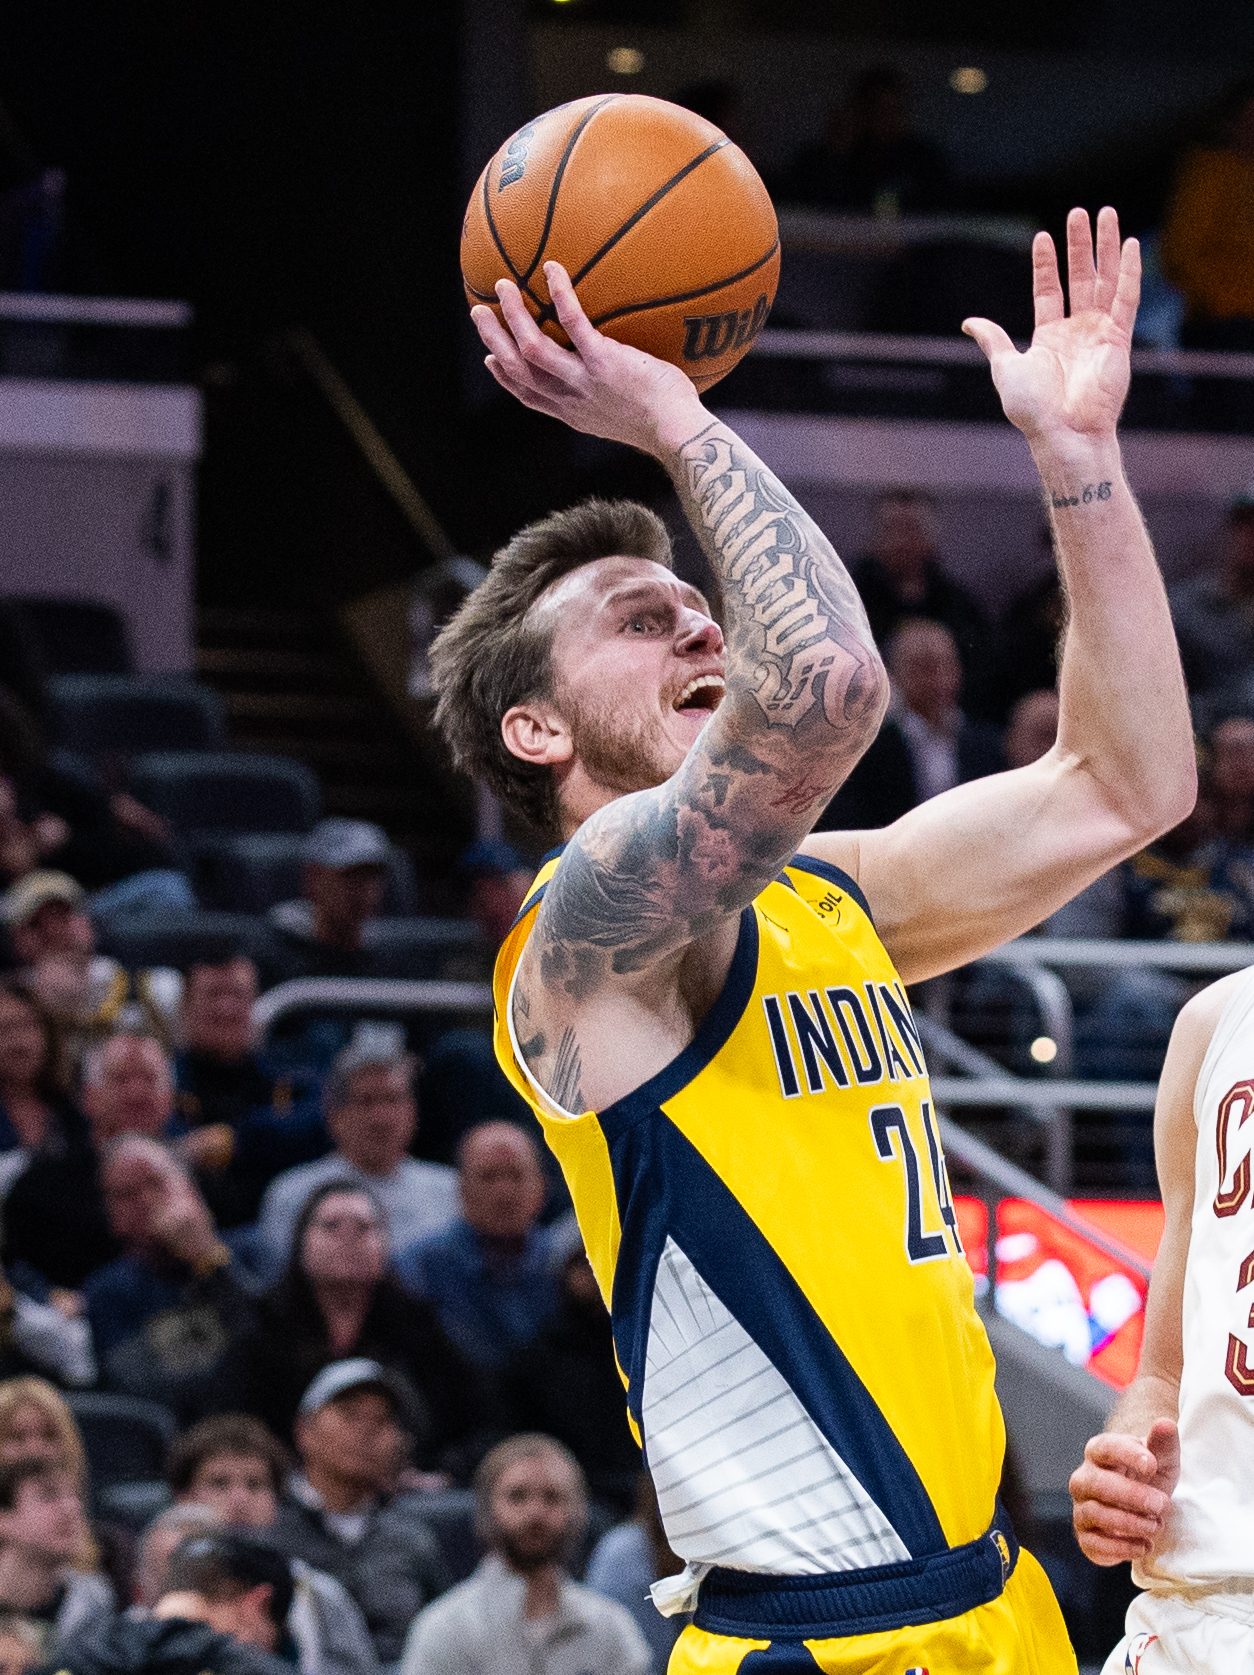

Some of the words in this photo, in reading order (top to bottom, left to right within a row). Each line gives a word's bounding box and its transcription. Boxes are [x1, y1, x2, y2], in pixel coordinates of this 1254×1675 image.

[818, 892, 843, 912] OIL
[762, 979, 928, 1100] INDIAN
[868, 1098, 966, 1266] 24
